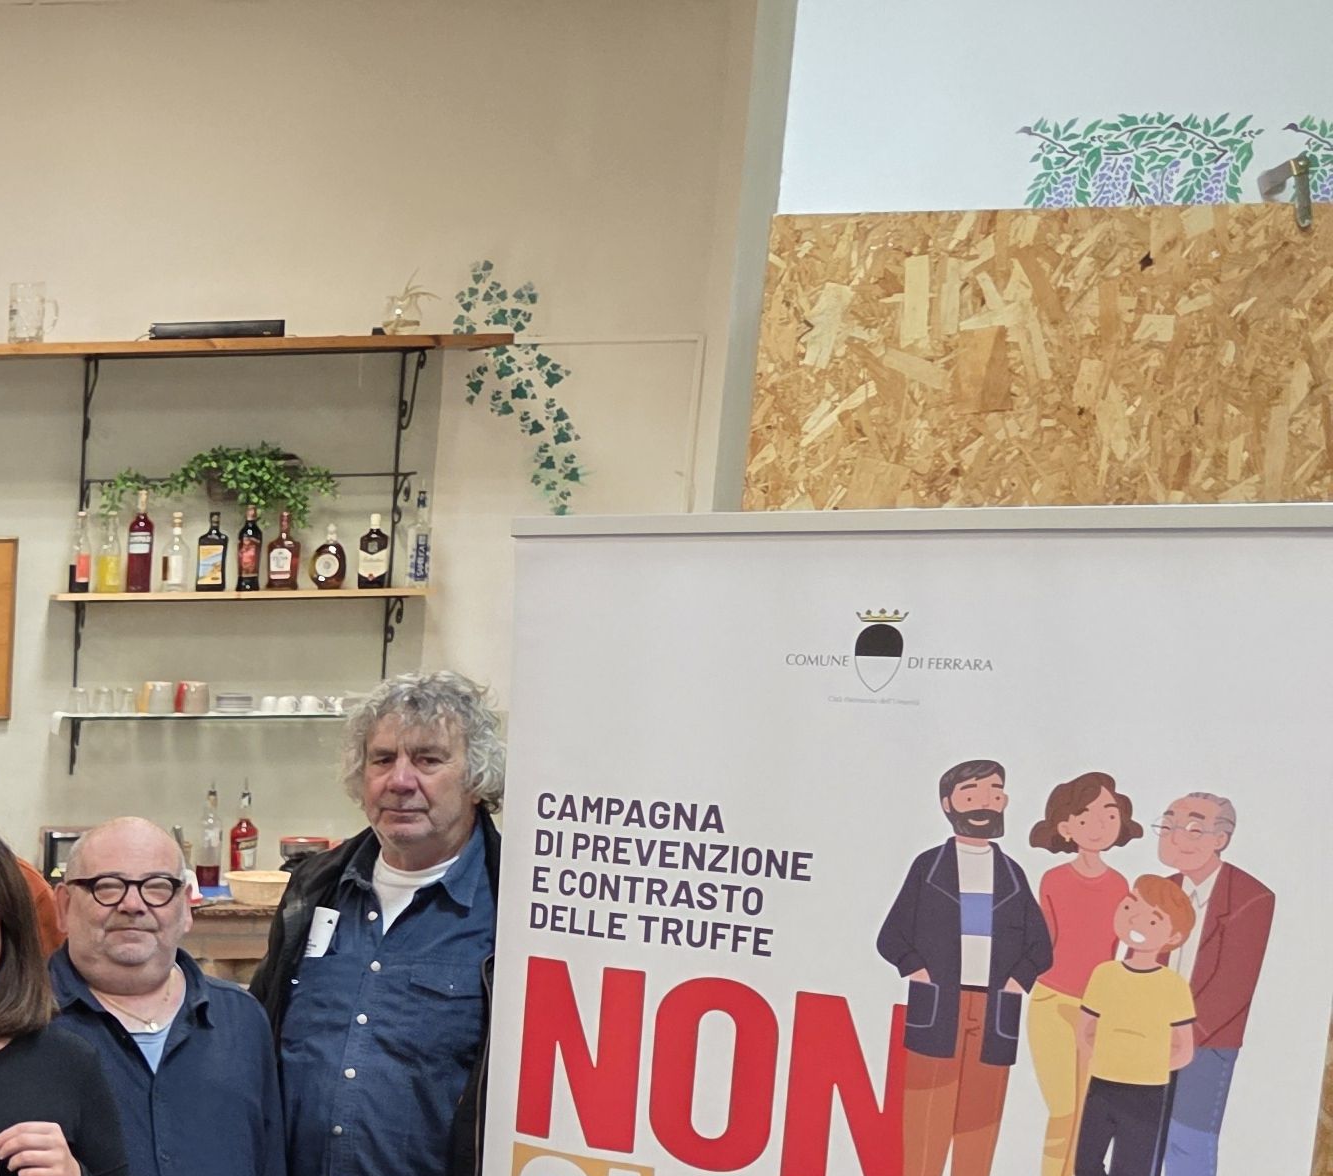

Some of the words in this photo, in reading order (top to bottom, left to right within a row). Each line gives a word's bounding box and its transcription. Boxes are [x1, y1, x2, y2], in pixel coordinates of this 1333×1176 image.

[785, 653, 850, 668] COMUNE
[907, 656, 923, 669] DI
[927, 657, 994, 672] FERRARA
[536, 792, 725, 834] CAMPAGNA
[534, 828, 565, 858] DI
[571, 833, 815, 883] PREVENZIONE
[532, 864, 550, 894] E
[557, 868, 764, 917] CONTRASTO
[529, 901, 627, 942] DELLE
[637, 914, 774, 958] TRUFFE
